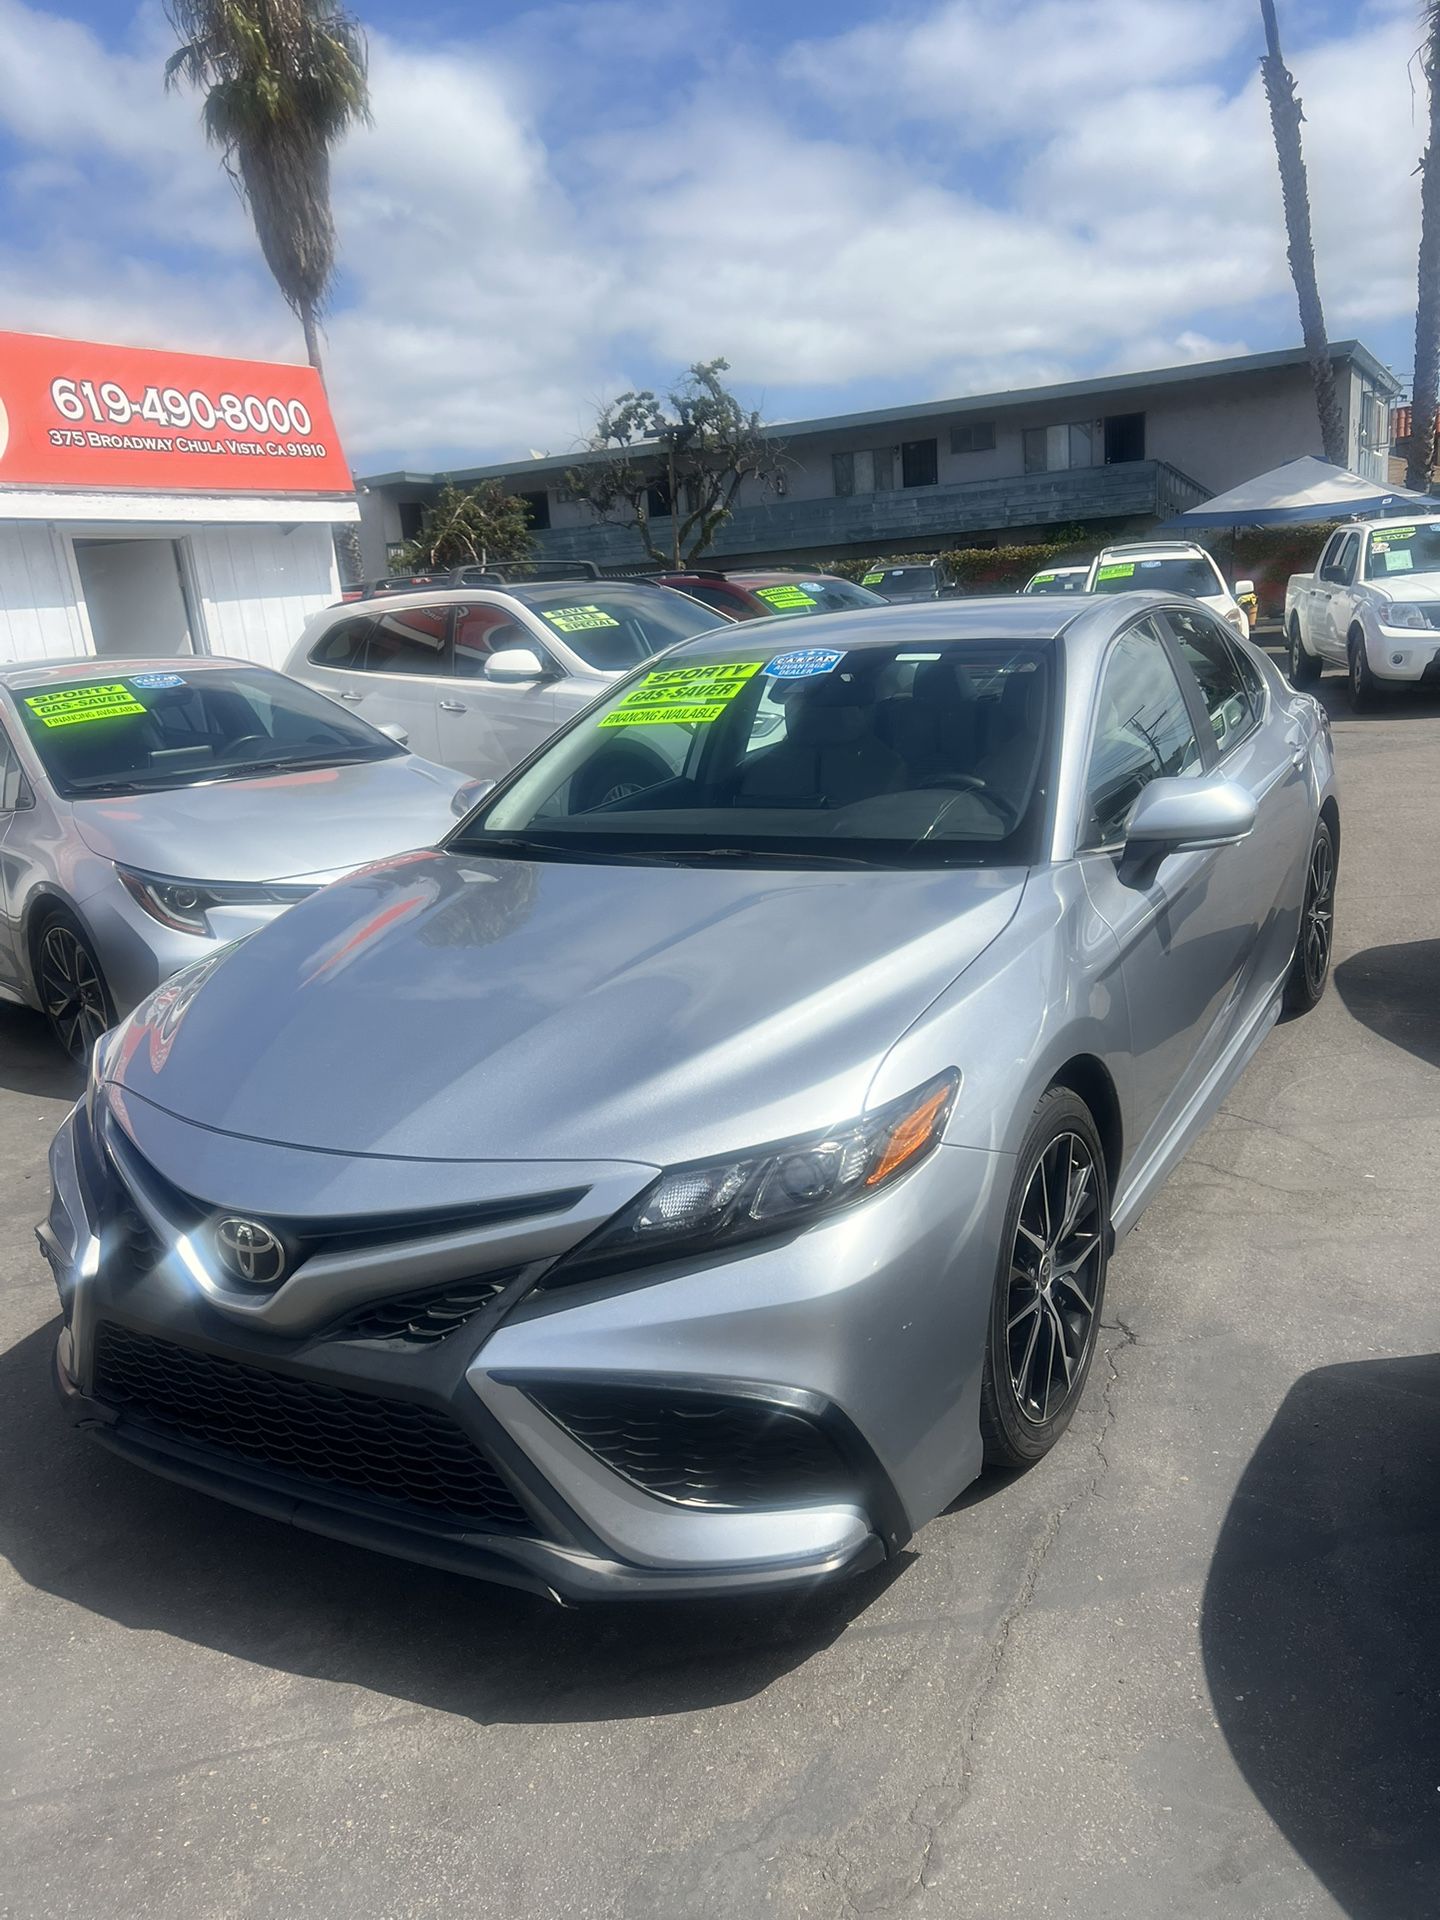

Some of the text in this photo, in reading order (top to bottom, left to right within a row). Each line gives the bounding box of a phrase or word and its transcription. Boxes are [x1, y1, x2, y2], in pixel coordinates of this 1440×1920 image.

[51, 376, 312, 436] 619-490-8000
[49, 429, 86, 447] 375
[87, 432, 173, 452] BROADWAY
[176, 437, 225, 454] CHULA
[226, 440, 265, 456] VISTA
[287, 442, 326, 458] 91910
[551, 607, 588, 616] SAVE
[562, 613, 599, 622] SALE
[565, 619, 614, 630] SPECIAL
[652, 664, 753, 684] SPORTY
[774, 662, 826, 671] ADVANTAGE
[778, 668, 814, 676] DEALER
[33, 686, 115, 704] SPORTY
[627, 683, 735, 704] GAS-SAVER
[41, 694, 128, 713] GAS-SAVER
[47, 705, 142, 725] FINANCING AVAILABLE
[606, 706, 721, 725] FINANCING AVAILABLE
